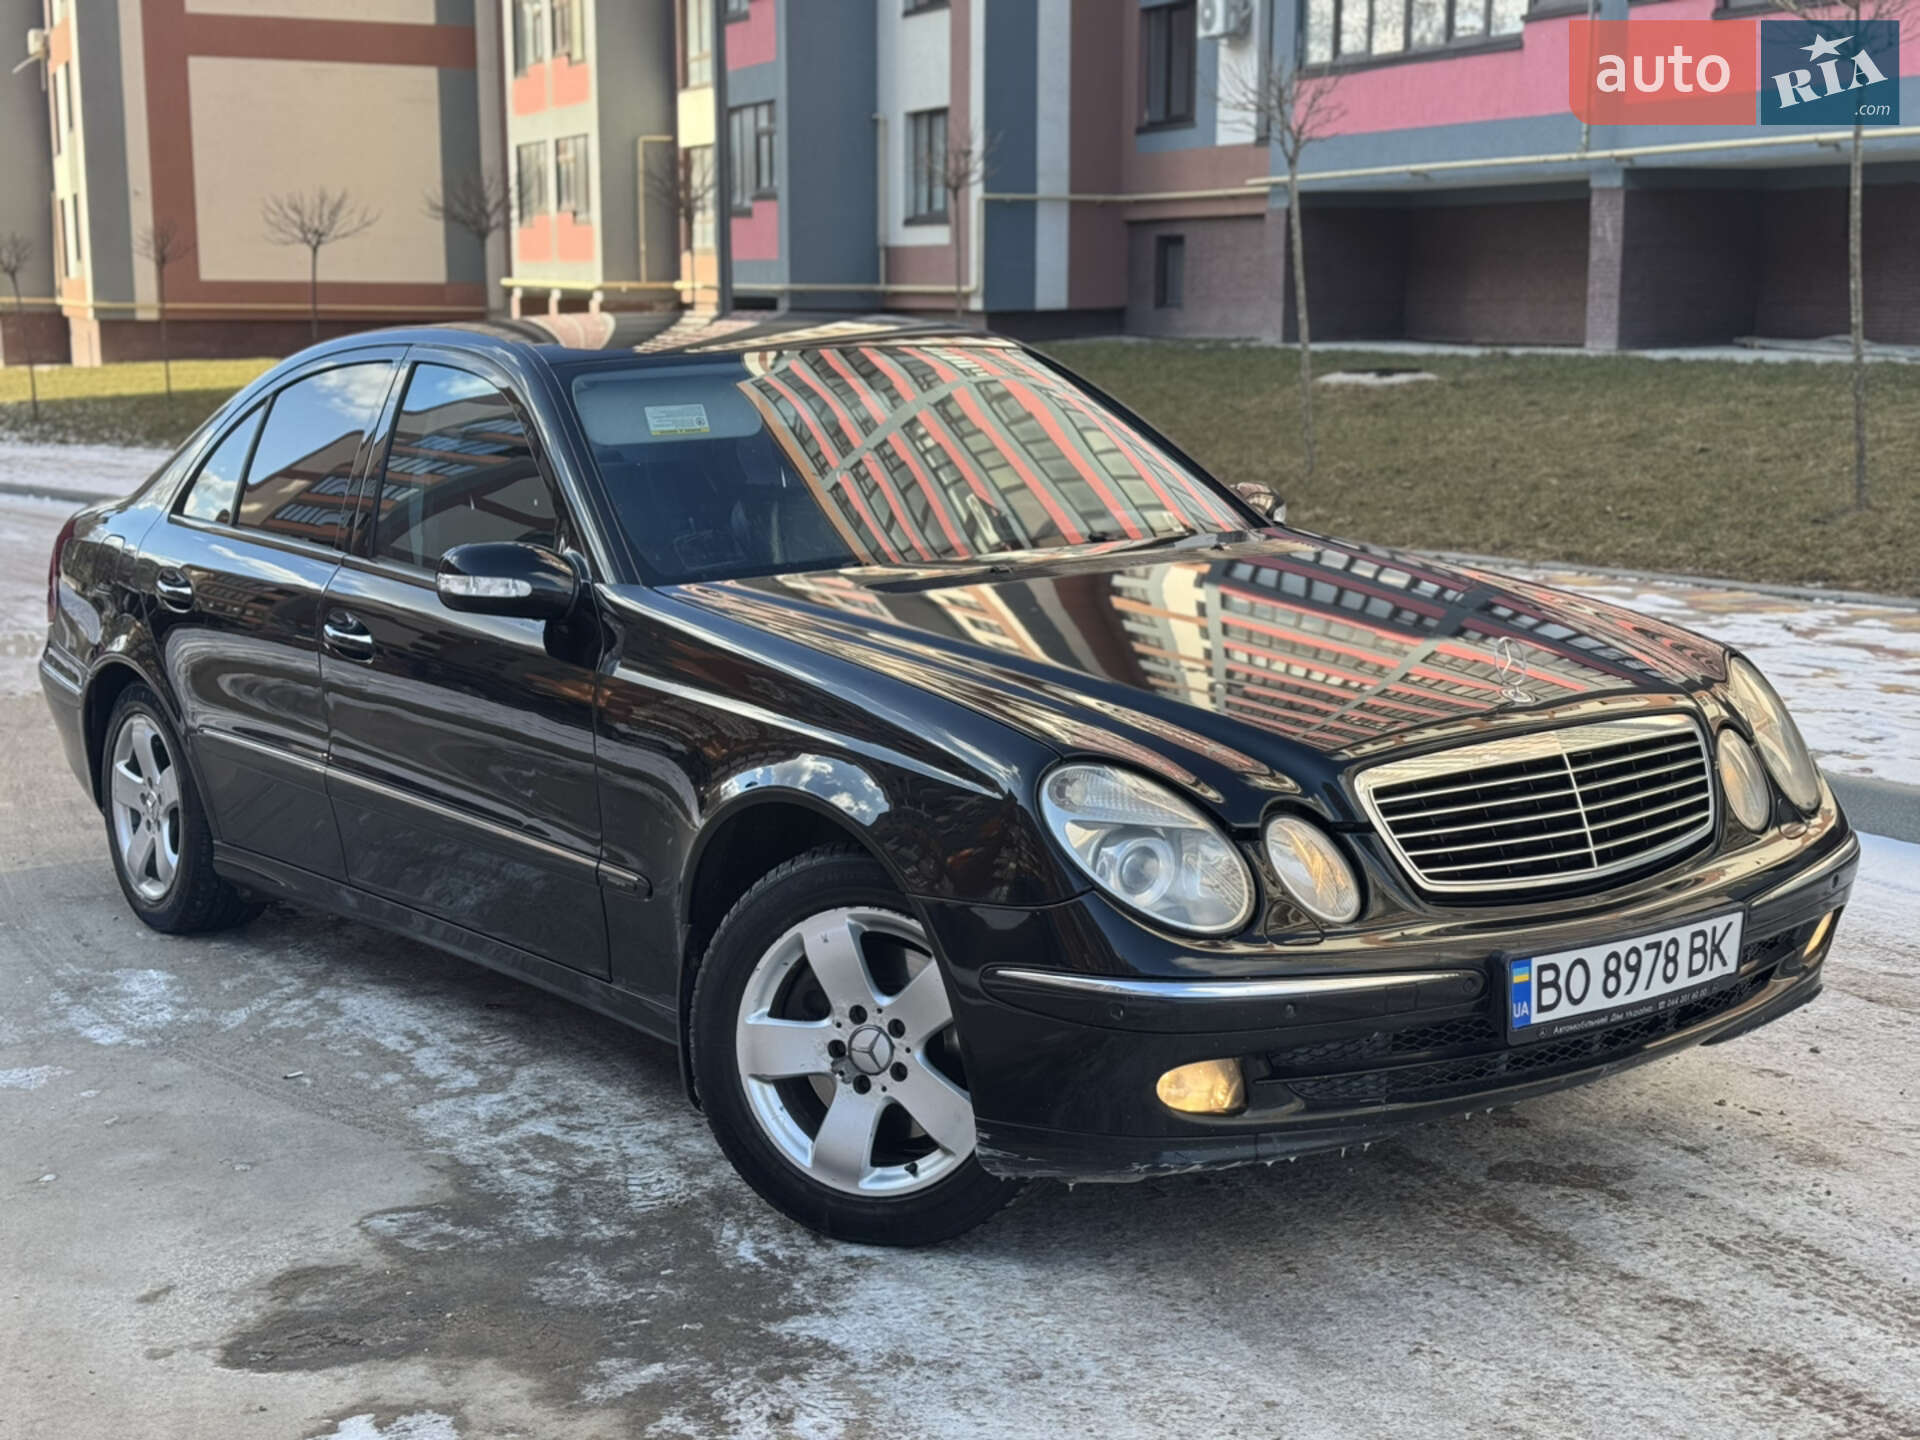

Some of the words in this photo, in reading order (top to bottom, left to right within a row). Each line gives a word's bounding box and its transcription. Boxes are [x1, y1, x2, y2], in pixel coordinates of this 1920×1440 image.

[1536, 957, 1591, 1014] BO
[1601, 936, 1680, 999] 8978
[1687, 921, 1734, 979] BK
[1512, 1001, 1529, 1019] UA
